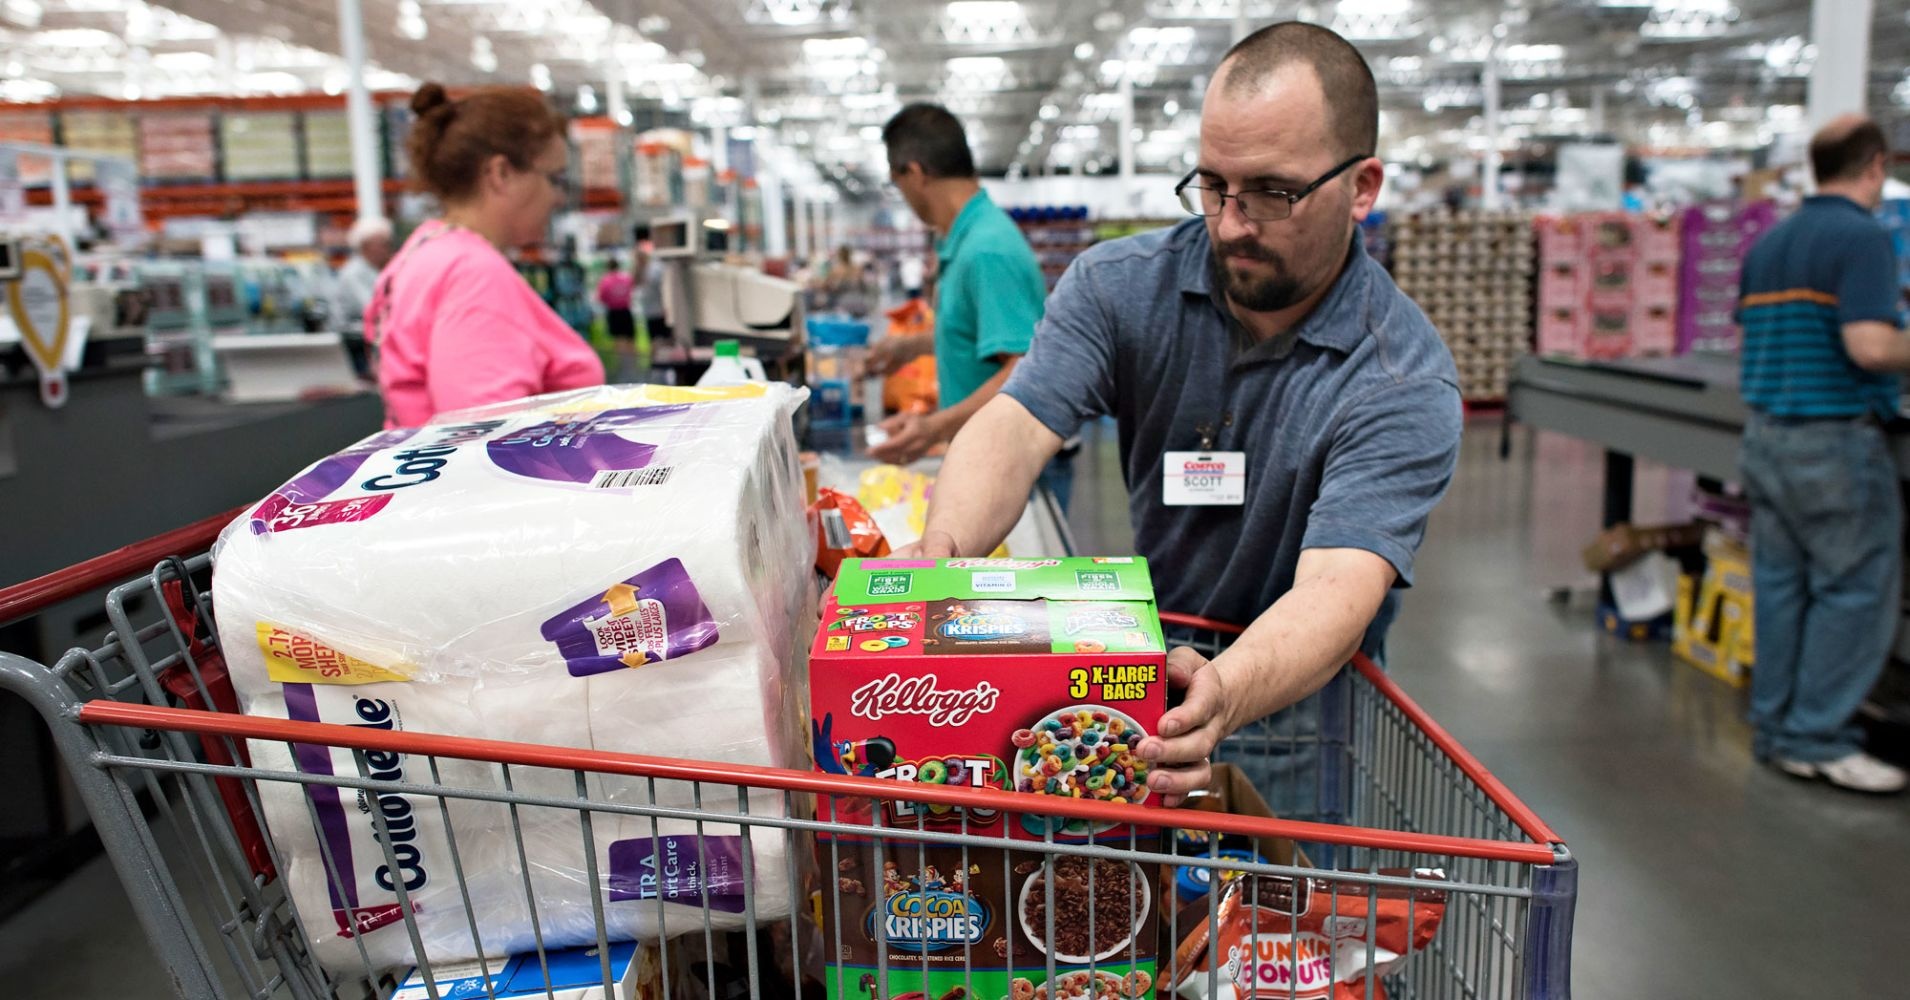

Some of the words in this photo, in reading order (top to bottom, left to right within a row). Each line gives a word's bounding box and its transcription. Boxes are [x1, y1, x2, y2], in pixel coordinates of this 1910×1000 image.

[1184, 476, 1222, 487] SCOTT
[844, 612, 910, 626] FROOT
[853, 620, 914, 632] LOOPS
[947, 623, 1025, 636] KRISPIES
[1069, 668, 1090, 700] 3
[1091, 665, 1157, 685] X-LARGE
[1102, 682, 1147, 701] BAGS
[851, 673, 1000, 727] Kellogg's
[892, 893, 965, 918] COCOA
[884, 914, 980, 940] KRISPIES
[1243, 957, 1331, 985] DONUTS
